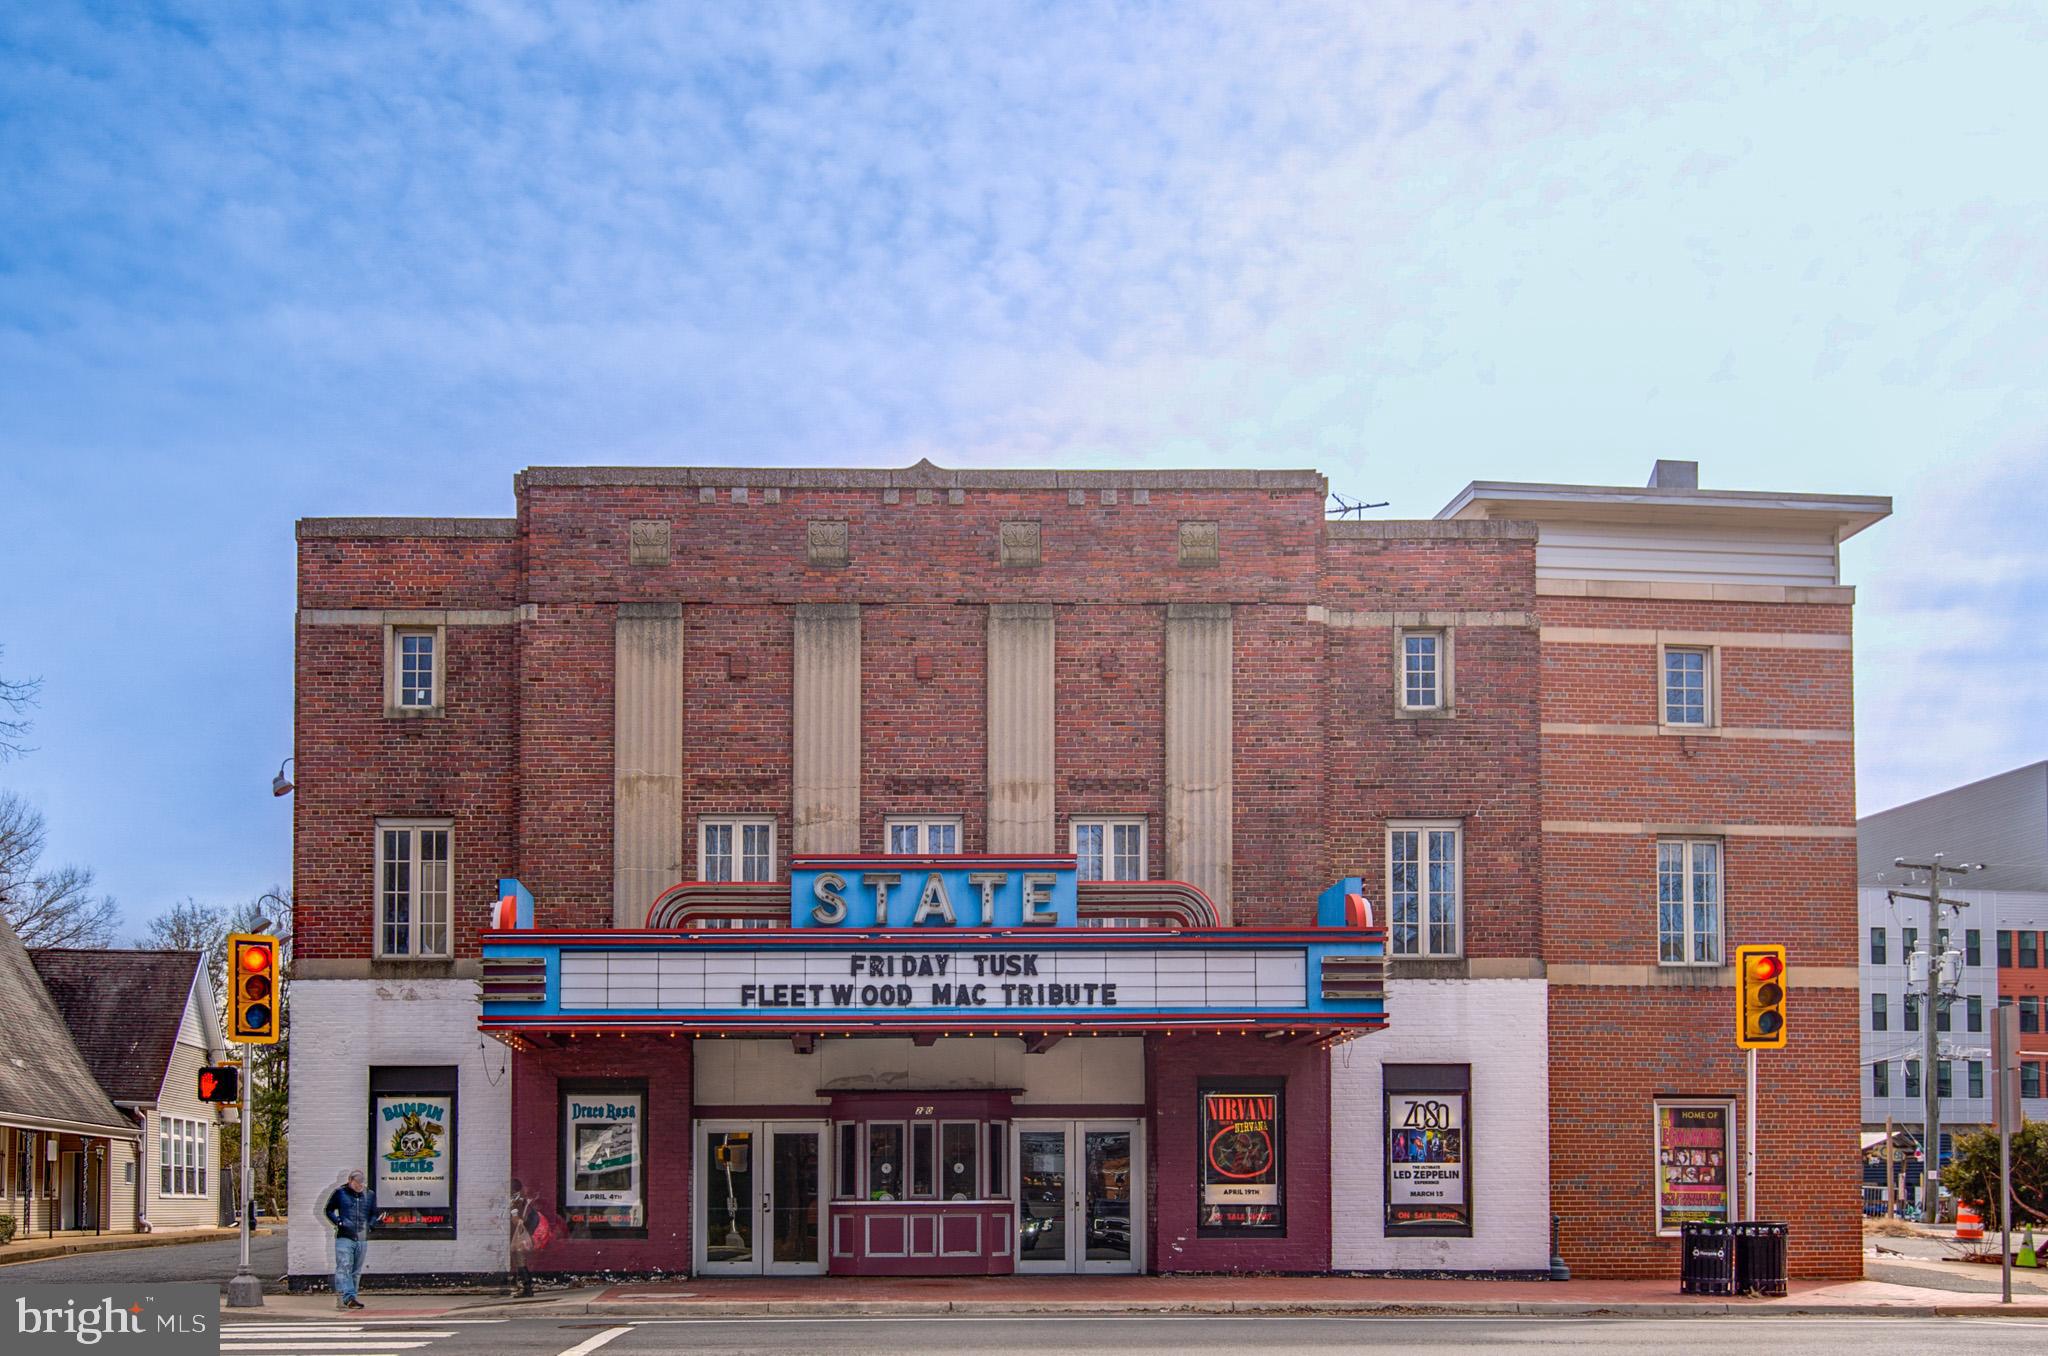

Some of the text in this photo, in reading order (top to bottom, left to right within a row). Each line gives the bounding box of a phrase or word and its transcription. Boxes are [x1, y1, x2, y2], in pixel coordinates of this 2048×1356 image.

[812, 872, 1058, 925] STATE
[851, 954, 1039, 977] FRIDAY TUSK
[741, 983, 1118, 1007] FLEETWOOD MAC TRIBUTE
[382, 1102, 445, 1121] BUMPIN
[572, 1103, 636, 1120] Draco Rosa
[1681, 1111, 1719, 1119] HOME OF
[1234, 1120, 1269, 1134] NIRVANA
[1393, 1170, 1460, 1179] LED ZEPPELIN
[383, 1215, 444, 1224] ON SALE NOW!
[571, 1215, 585, 1223] ON
[588, 1215, 608, 1223] SALE
